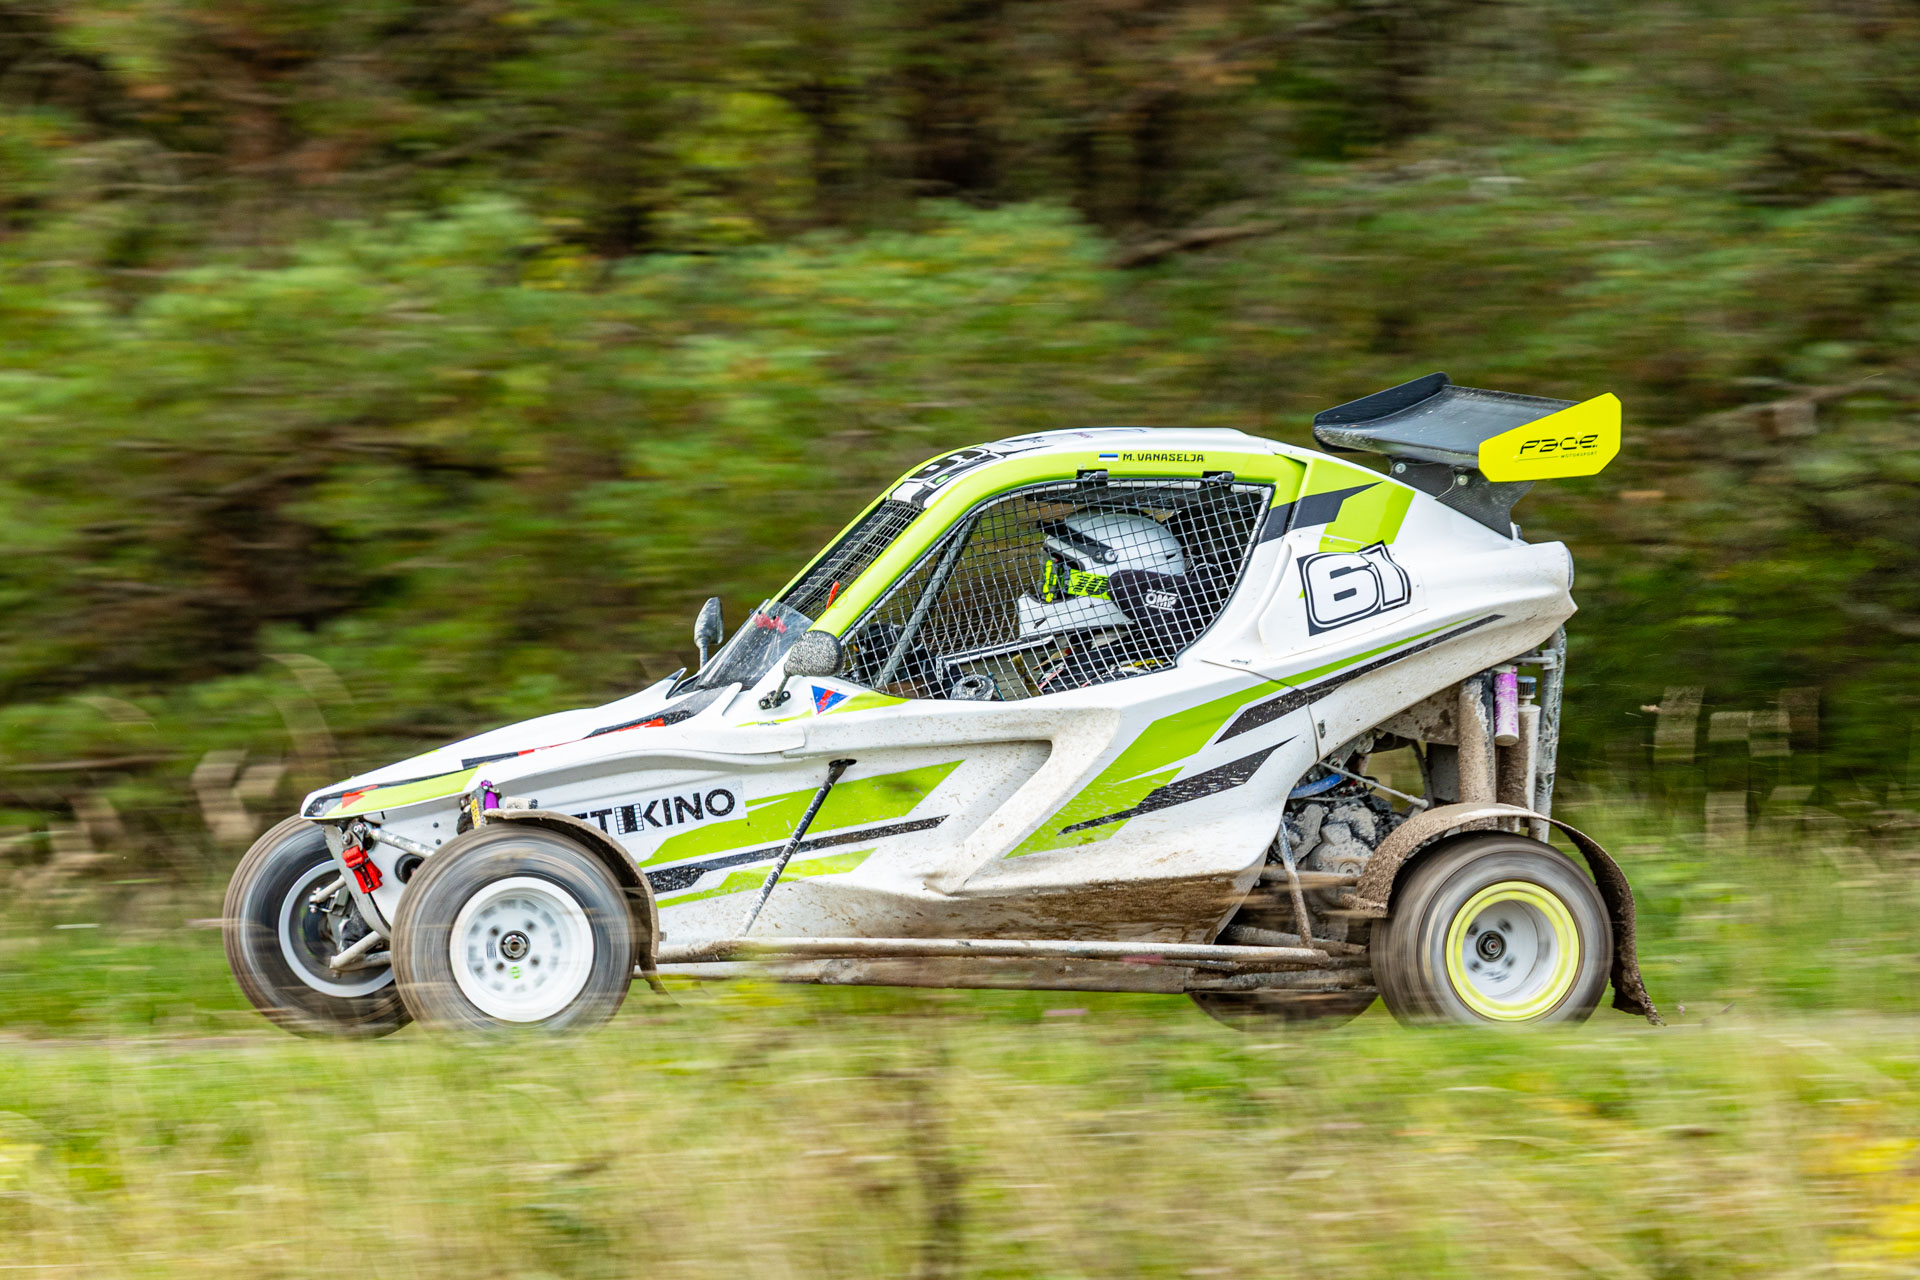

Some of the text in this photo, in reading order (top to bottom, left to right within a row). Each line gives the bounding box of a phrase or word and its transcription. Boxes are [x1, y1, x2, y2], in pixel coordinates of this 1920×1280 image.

[1122, 453, 1204, 462] M. VANASELJA
[1299, 541, 1411, 633] 61
[1145, 590, 1178, 610] OMP
